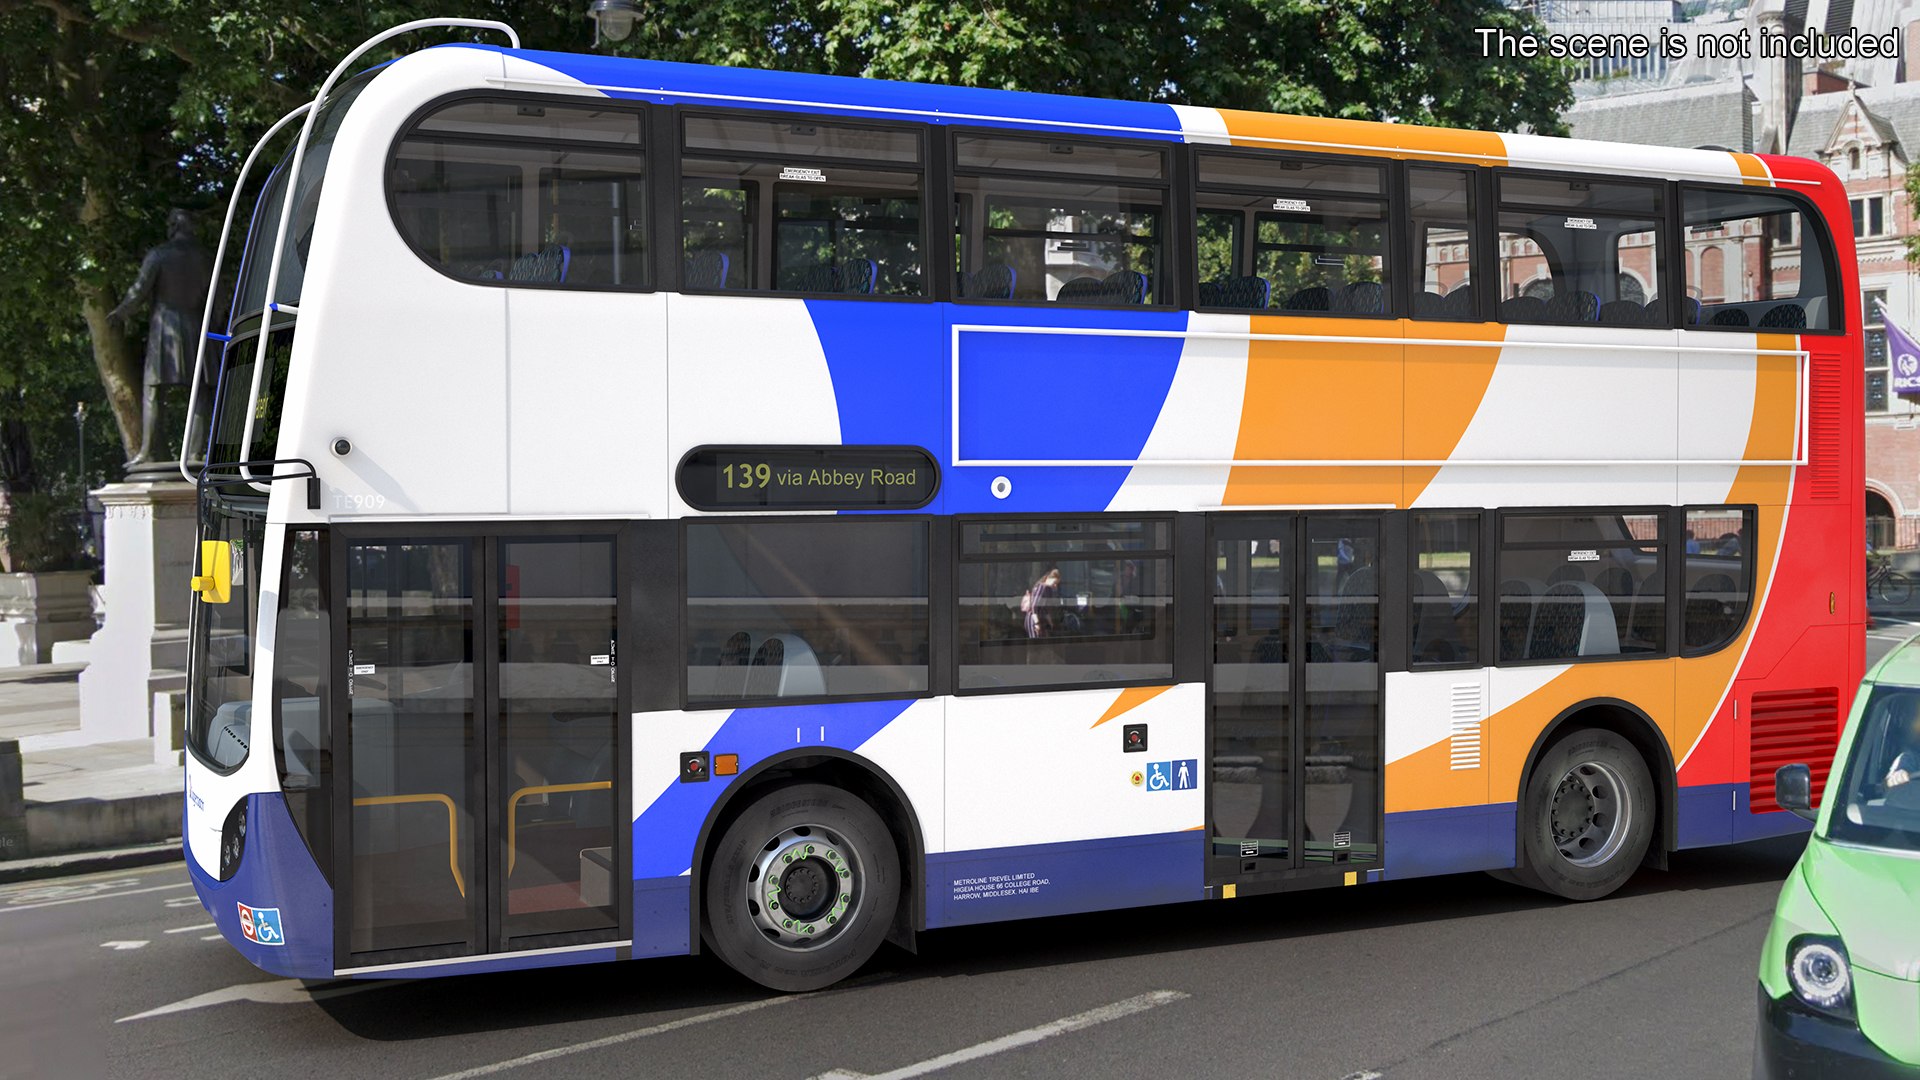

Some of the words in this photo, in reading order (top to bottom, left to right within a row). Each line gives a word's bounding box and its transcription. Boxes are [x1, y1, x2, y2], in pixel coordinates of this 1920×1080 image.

[723, 463, 771, 489] 139
[777, 469, 803, 486] via
[808, 469, 864, 489] Abbey
[871, 469, 916, 486] Road
[333, 494, 386, 509] TE909
[953, 877, 987, 886] METROLINE
[1012, 872, 1035, 881] LIMITED
[975, 883, 995, 892] HOUSE
[1004, 880, 1031, 889] COLLEGE
